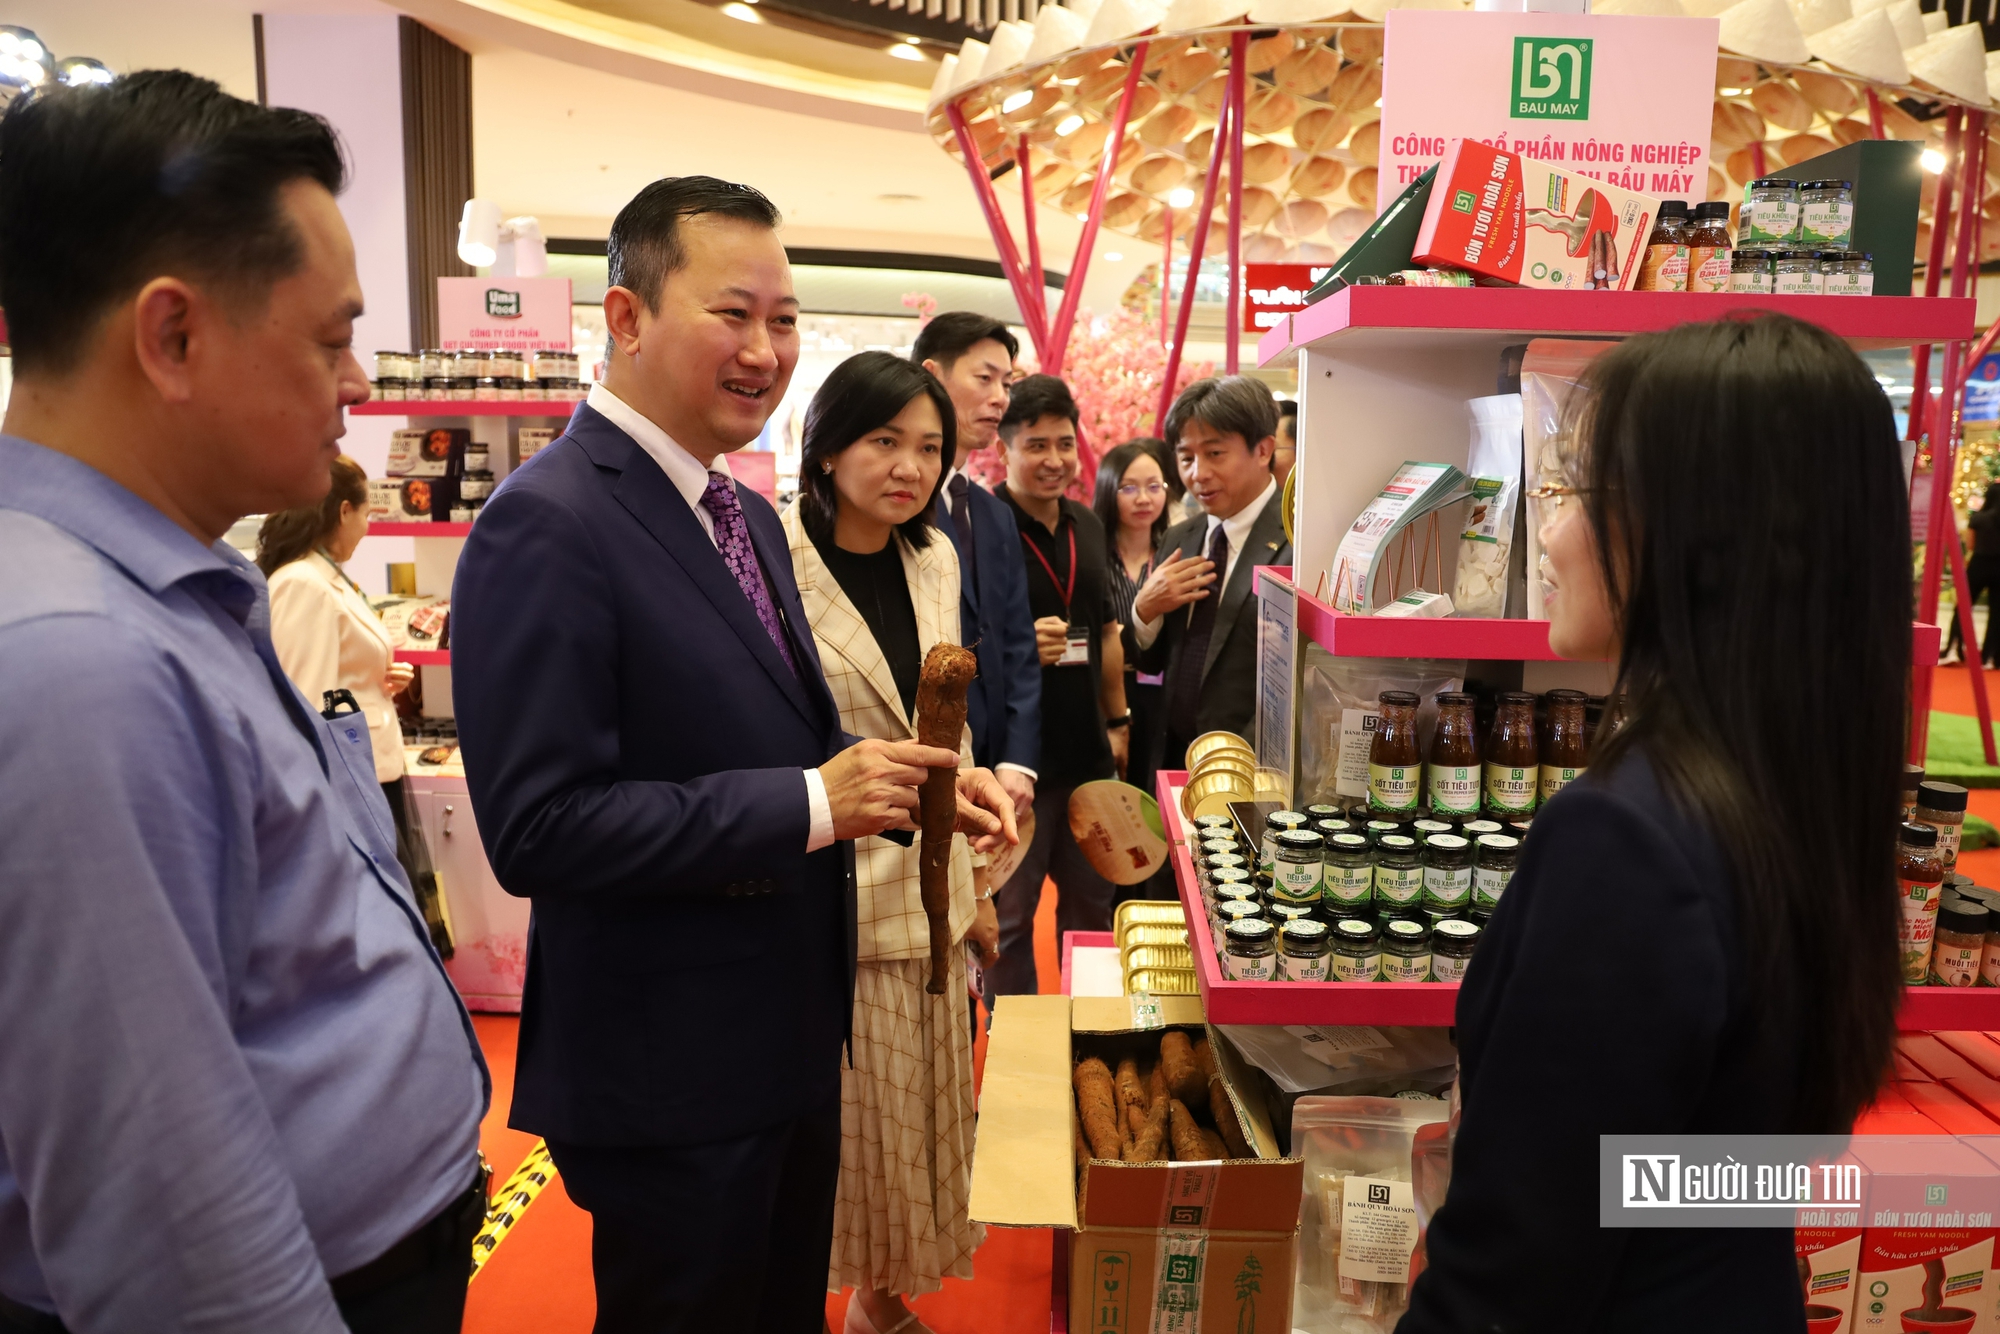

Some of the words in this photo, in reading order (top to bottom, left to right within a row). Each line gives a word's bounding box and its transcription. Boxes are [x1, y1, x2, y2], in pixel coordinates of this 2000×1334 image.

[1519, 102, 1547, 114] BAU
[1550, 103, 1579, 115] MAY
[1393, 132, 1445, 156] CÔNG
[1514, 134, 1565, 160] PHẦN
[1572, 138, 1623, 162] NÔNG
[1631, 141, 1701, 169] NGHIỆP
[1491, 154, 1510, 180] SƠN
[1608, 165, 1645, 191] BẦU
[1651, 169, 1694, 193] MÂY
[1481, 180, 1502, 209] HOÀI
[1488, 227, 1499, 249] FRESH
[1495, 210, 1504, 226] YAM
[1501, 178, 1514, 209] NOODLE
[1472, 209, 1493, 237] TƯƠI
[1464, 238, 1484, 264] BÚN
[490, 303, 517, 314] Food
[470, 328, 490, 338] CÔNG
[494, 330, 502, 338] TY
[1375, 778, 1386, 789] SỐT
[1388, 780, 1403, 789] TIÊU
[1437, 779, 1449, 790] SỐT
[1452, 781, 1467, 790] TIÊU
[1493, 779, 1506, 789] SỐT
[1508, 781, 1523, 790] TIÊU
[1544, 779, 1556, 789] SỐT
[1286, 873, 1300, 881] TIÊU
[1328, 875, 1339, 883] TIÊU
[1381, 877, 1393, 885] TIÊU
[1429, 877, 1440, 885] TIÊU
[1483, 879, 1495, 887] TIÊU
[1945, 957, 1964, 967] MUỐI
[1337, 965, 1351, 973] TIÊU
[1385, 964, 1398, 973] TIÊU
[1437, 965, 1449, 973] TIÊU
[1801, 1210, 1830, 1226] HOÀI
[1834, 1211, 1858, 1226] SƠN
[1874, 1210, 1899, 1226] BÚN
[1904, 1211, 1932, 1227] TƯƠI
[1936, 1210, 1965, 1228] HOÀI
[1968, 1212, 1992, 1228] SƠN
[1805, 1242, 1825, 1251] khẩu
[1874, 1246, 1889, 1258] Bún
[1891, 1251, 1907, 1259] hữu
[1920, 1247, 1937, 1257] xuất
[1939, 1243, 1959, 1252] khẩu
